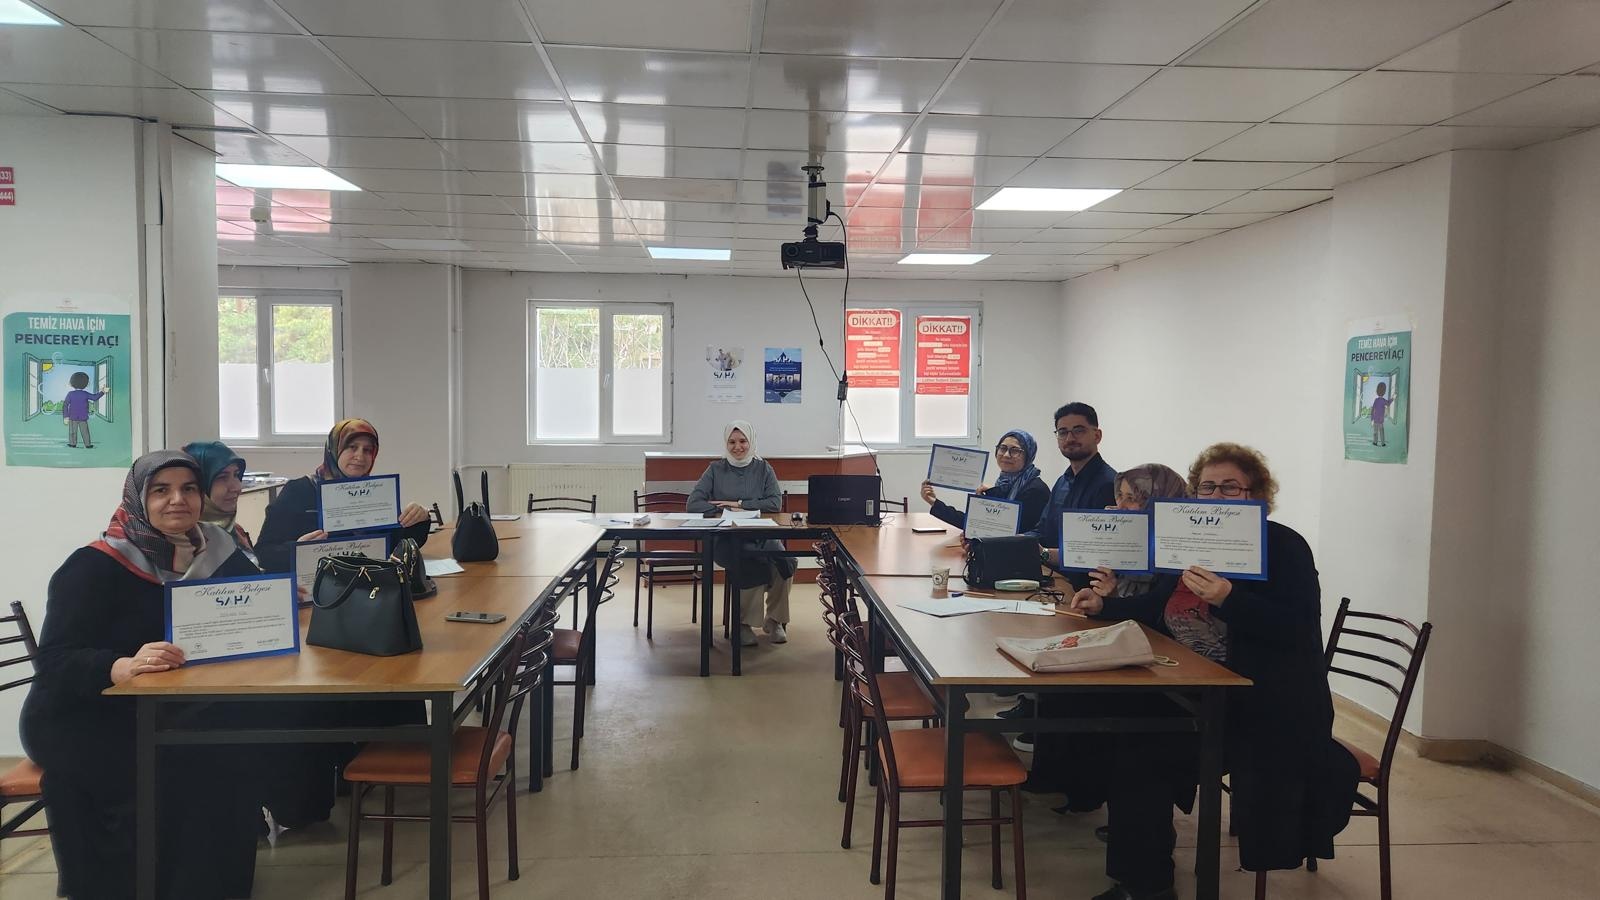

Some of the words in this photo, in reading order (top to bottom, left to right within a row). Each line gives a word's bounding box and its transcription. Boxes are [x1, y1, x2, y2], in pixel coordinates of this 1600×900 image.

[27, 315, 57, 330] TEMİZ
[59, 317, 85, 331] HAVA
[86, 315, 106, 333] İÇİN
[851, 315, 893, 326] DİKKAT!!
[922, 323, 963, 333] DİKKAT!!
[14, 332, 96, 346] PENCEREYİ
[96, 335, 119, 348] AÇ!
[1350, 349, 1391, 362] PENCEREYİ
[1391, 349, 1405, 361] AÇ!
